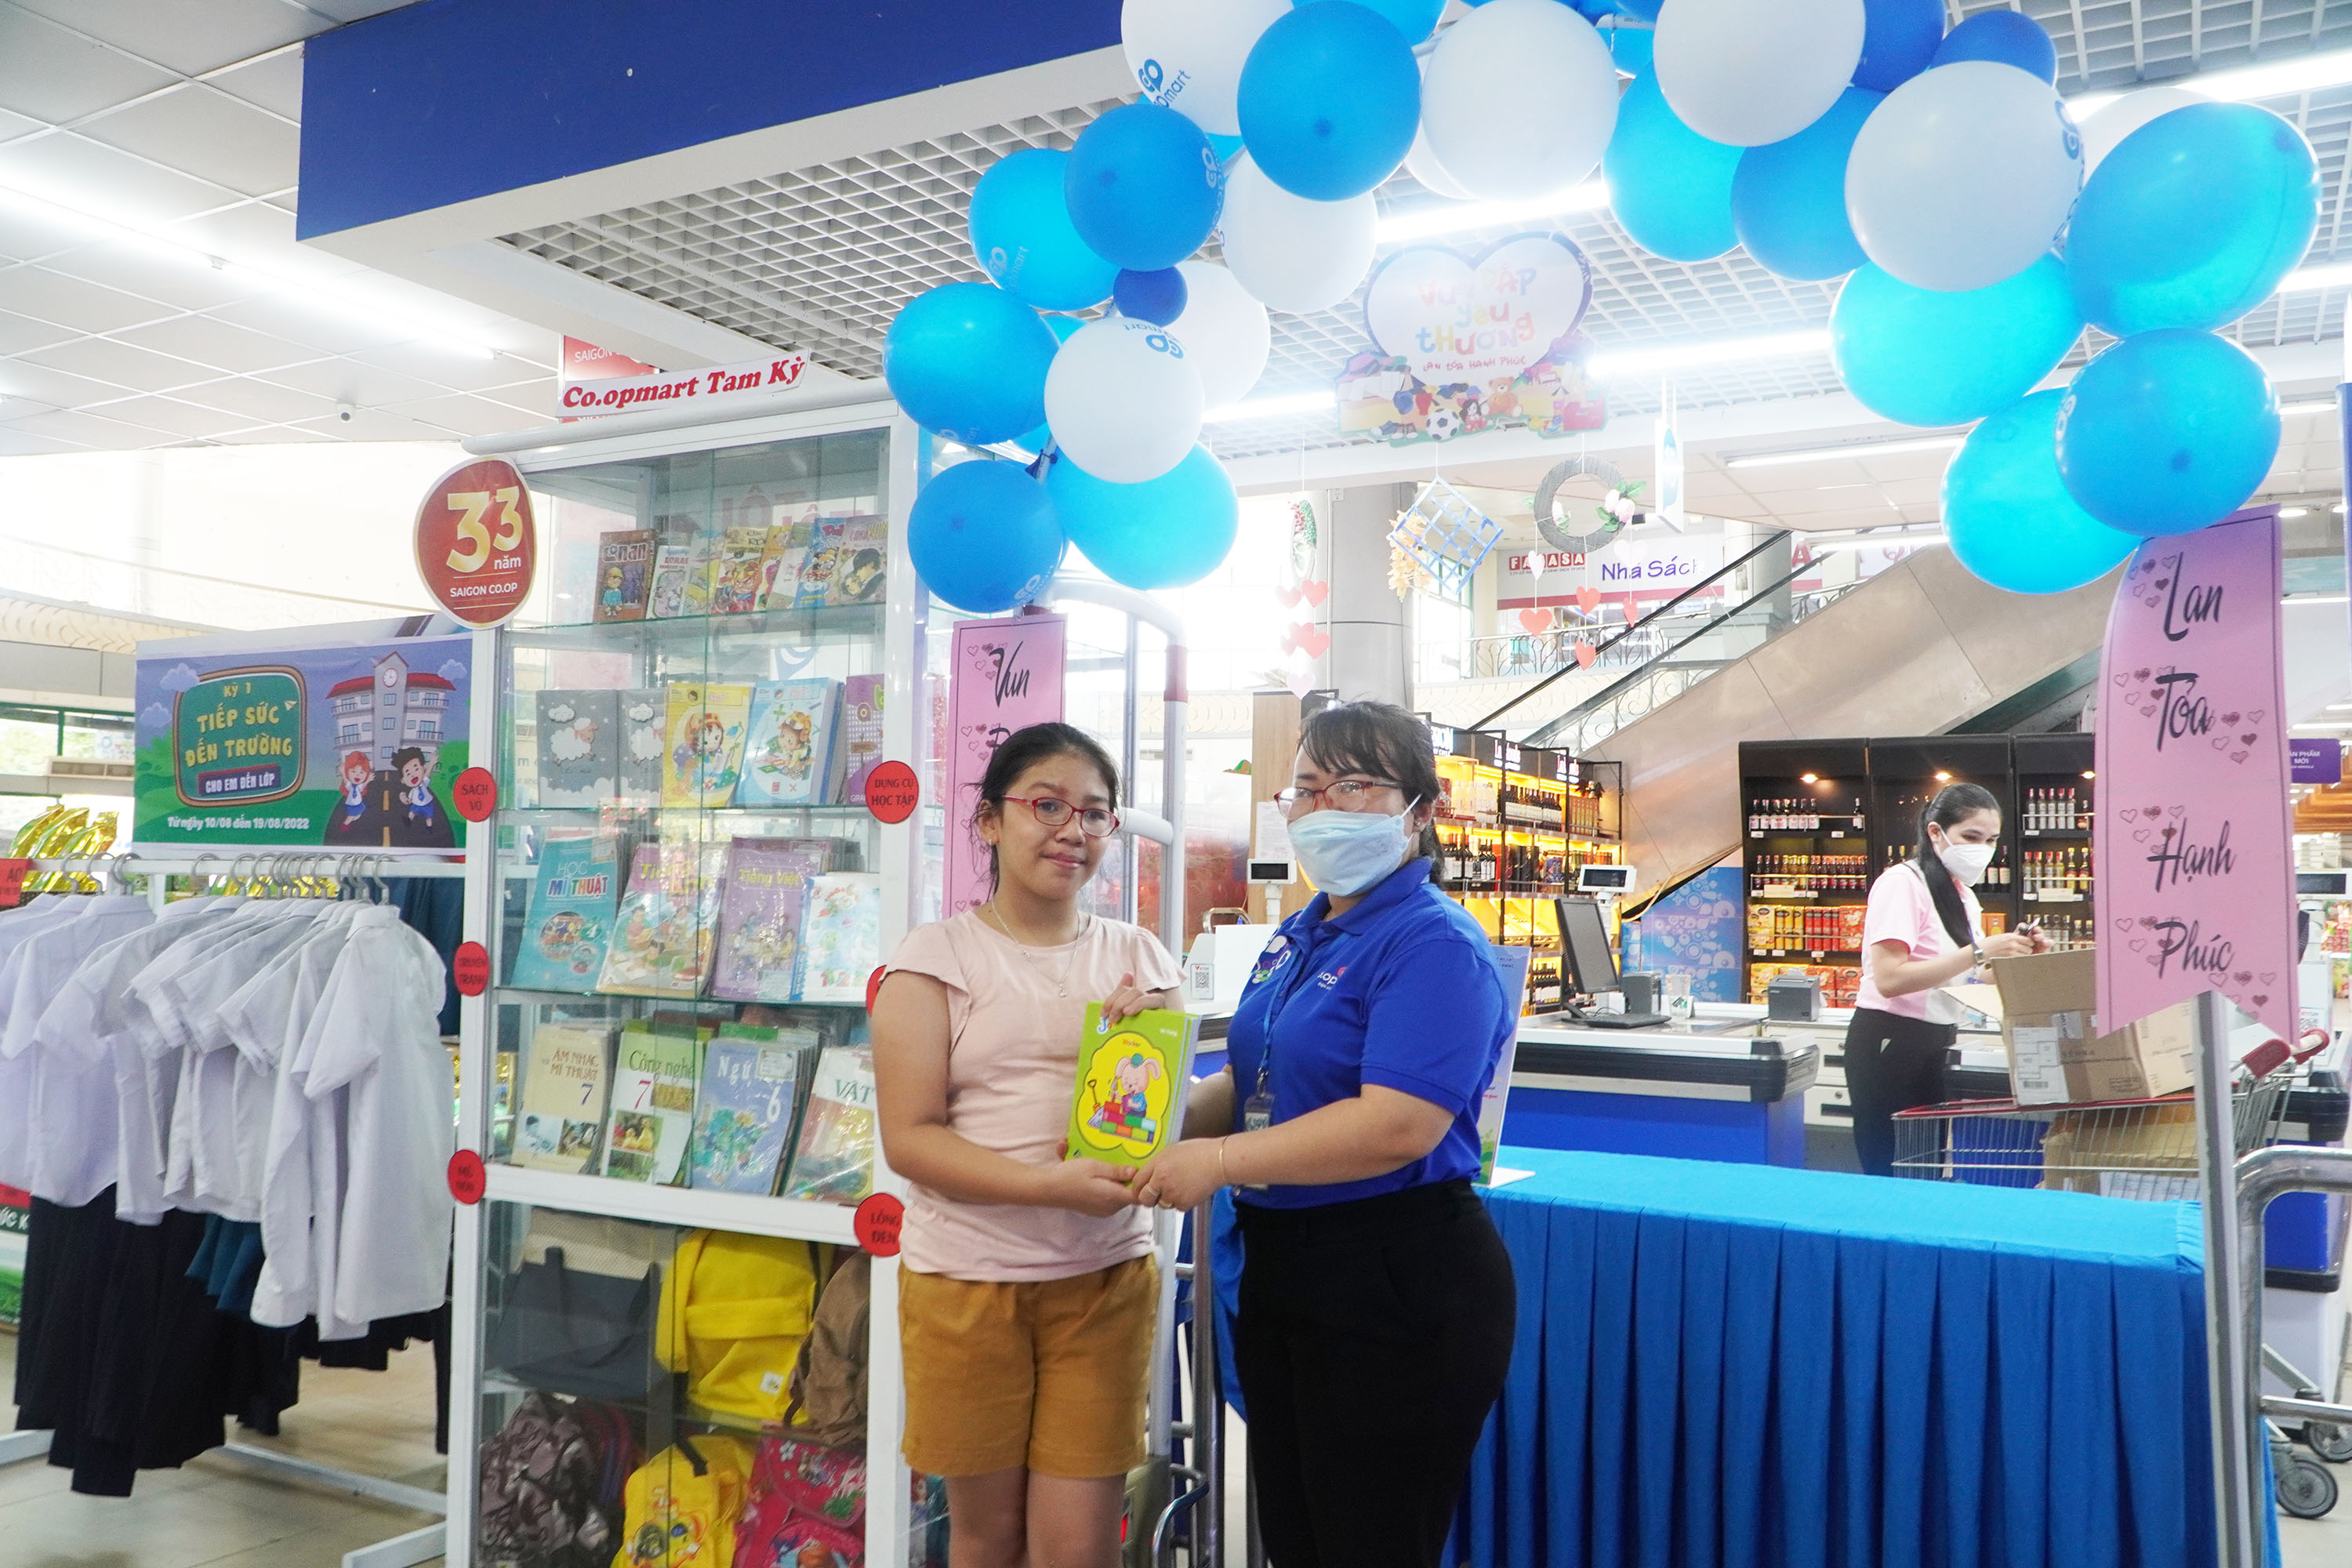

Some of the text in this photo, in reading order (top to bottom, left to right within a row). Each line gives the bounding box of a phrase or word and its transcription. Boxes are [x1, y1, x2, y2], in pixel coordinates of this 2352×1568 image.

[563, 377, 699, 408] Co.opmart
[707, 371, 761, 394] Tam
[446, 486, 523, 573] 33
[494, 555, 521, 570] năm
[1509, 552, 1585, 571] FAASA
[449, 583, 517, 597] SAIGON CO.OP
[2164, 551, 2223, 642] Lan
[989, 641, 1029, 707] Vun
[197, 701, 280, 733] TIẾP SỨC
[2154, 666, 2209, 753] Tỏa
[185, 731, 293, 768] ĐẾN TRƯỜNG
[205, 771, 275, 793] CHO EM ĐẾN LỚP
[205, 817, 232, 829] 10/08
[2147, 817, 2234, 892] Hạnh
[2154, 920, 2234, 978] Phúc
[582, 1083, 593, 1105] 7
[638, 1080, 651, 1109] 7
[766, 1085, 782, 1123] 6
